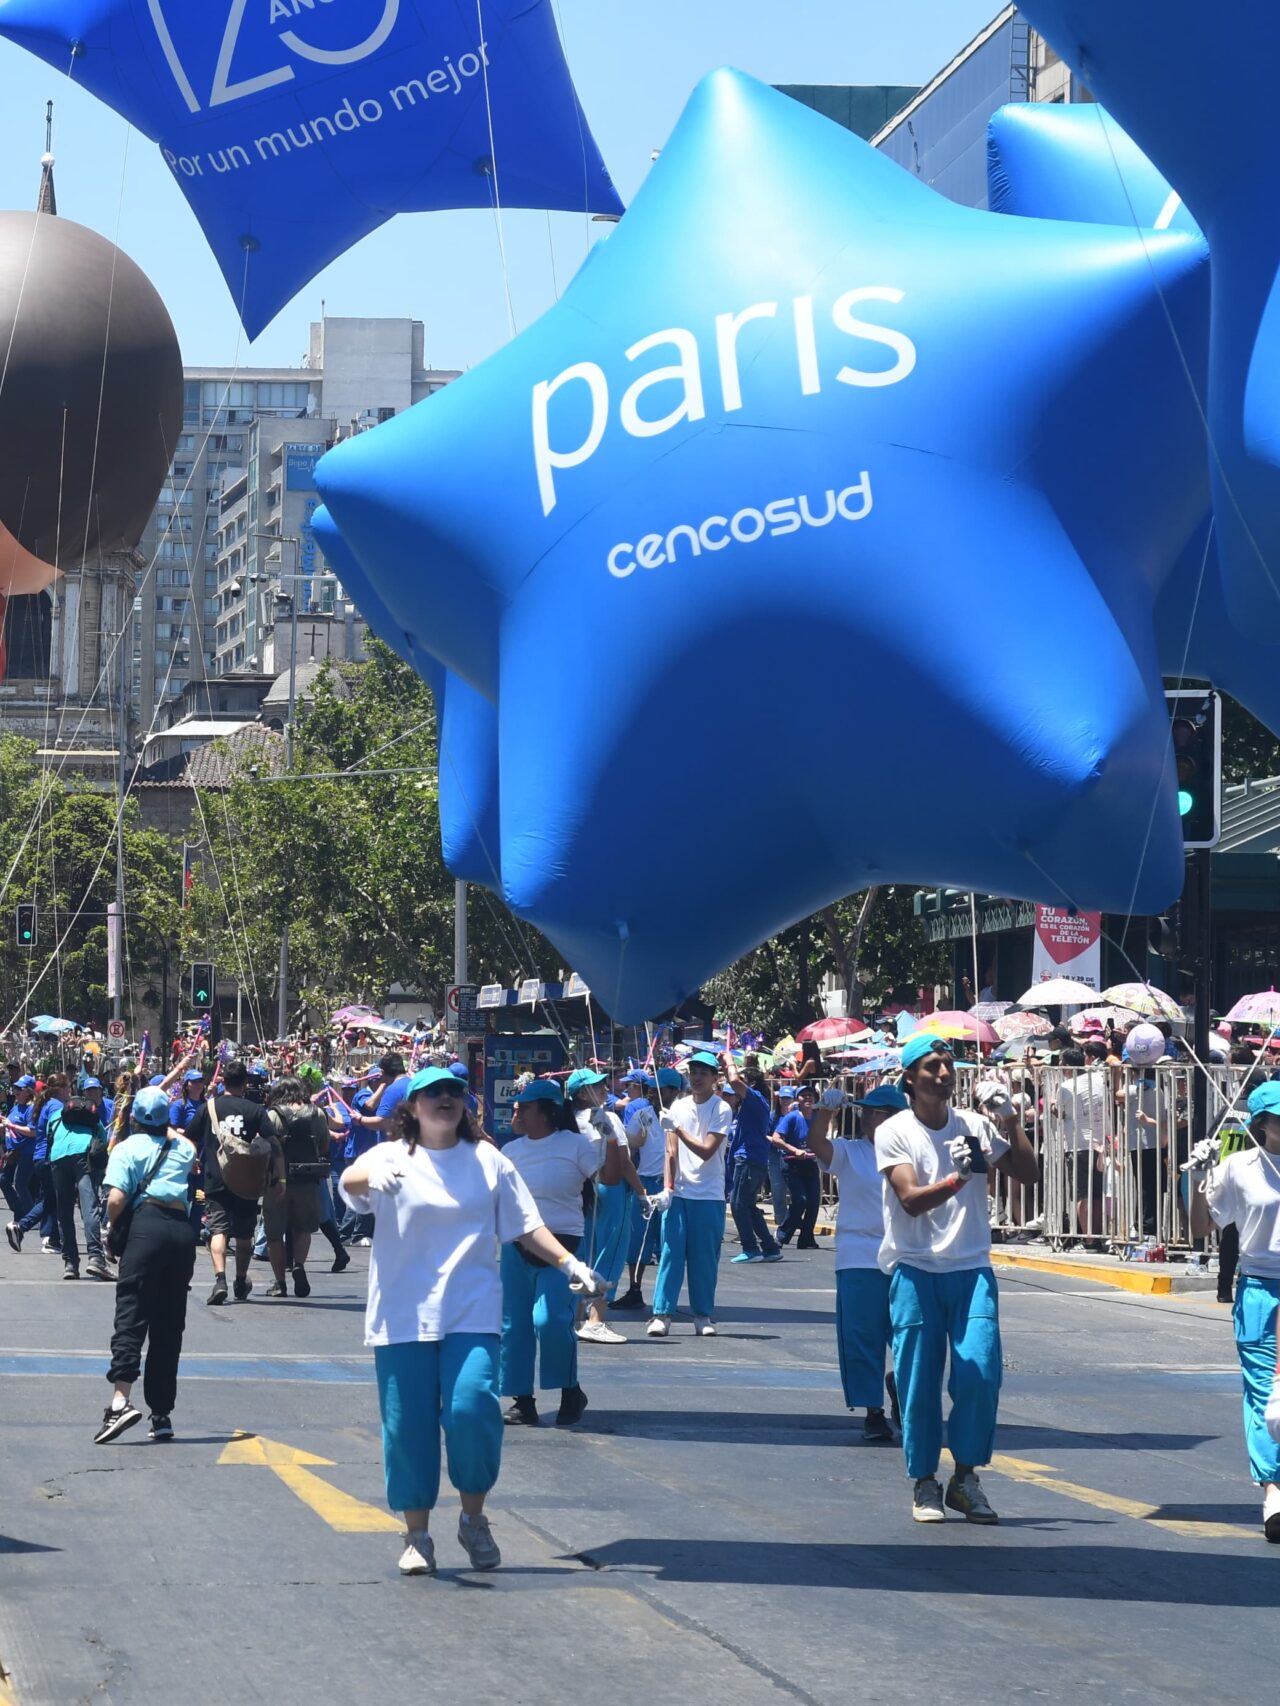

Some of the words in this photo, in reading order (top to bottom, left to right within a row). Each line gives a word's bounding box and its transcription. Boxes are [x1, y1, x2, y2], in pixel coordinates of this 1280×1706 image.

[164, 148, 204, 177] Por
[208, 144, 251, 173] un
[254, 97, 383, 160] mundo
[389, 42, 490, 111] mejor
[532, 286, 917, 518] paris
[607, 471, 873, 578] cencosud
[1051, 935, 1089, 944] TELETÓN
[500, 1086, 519, 1097] Lid
